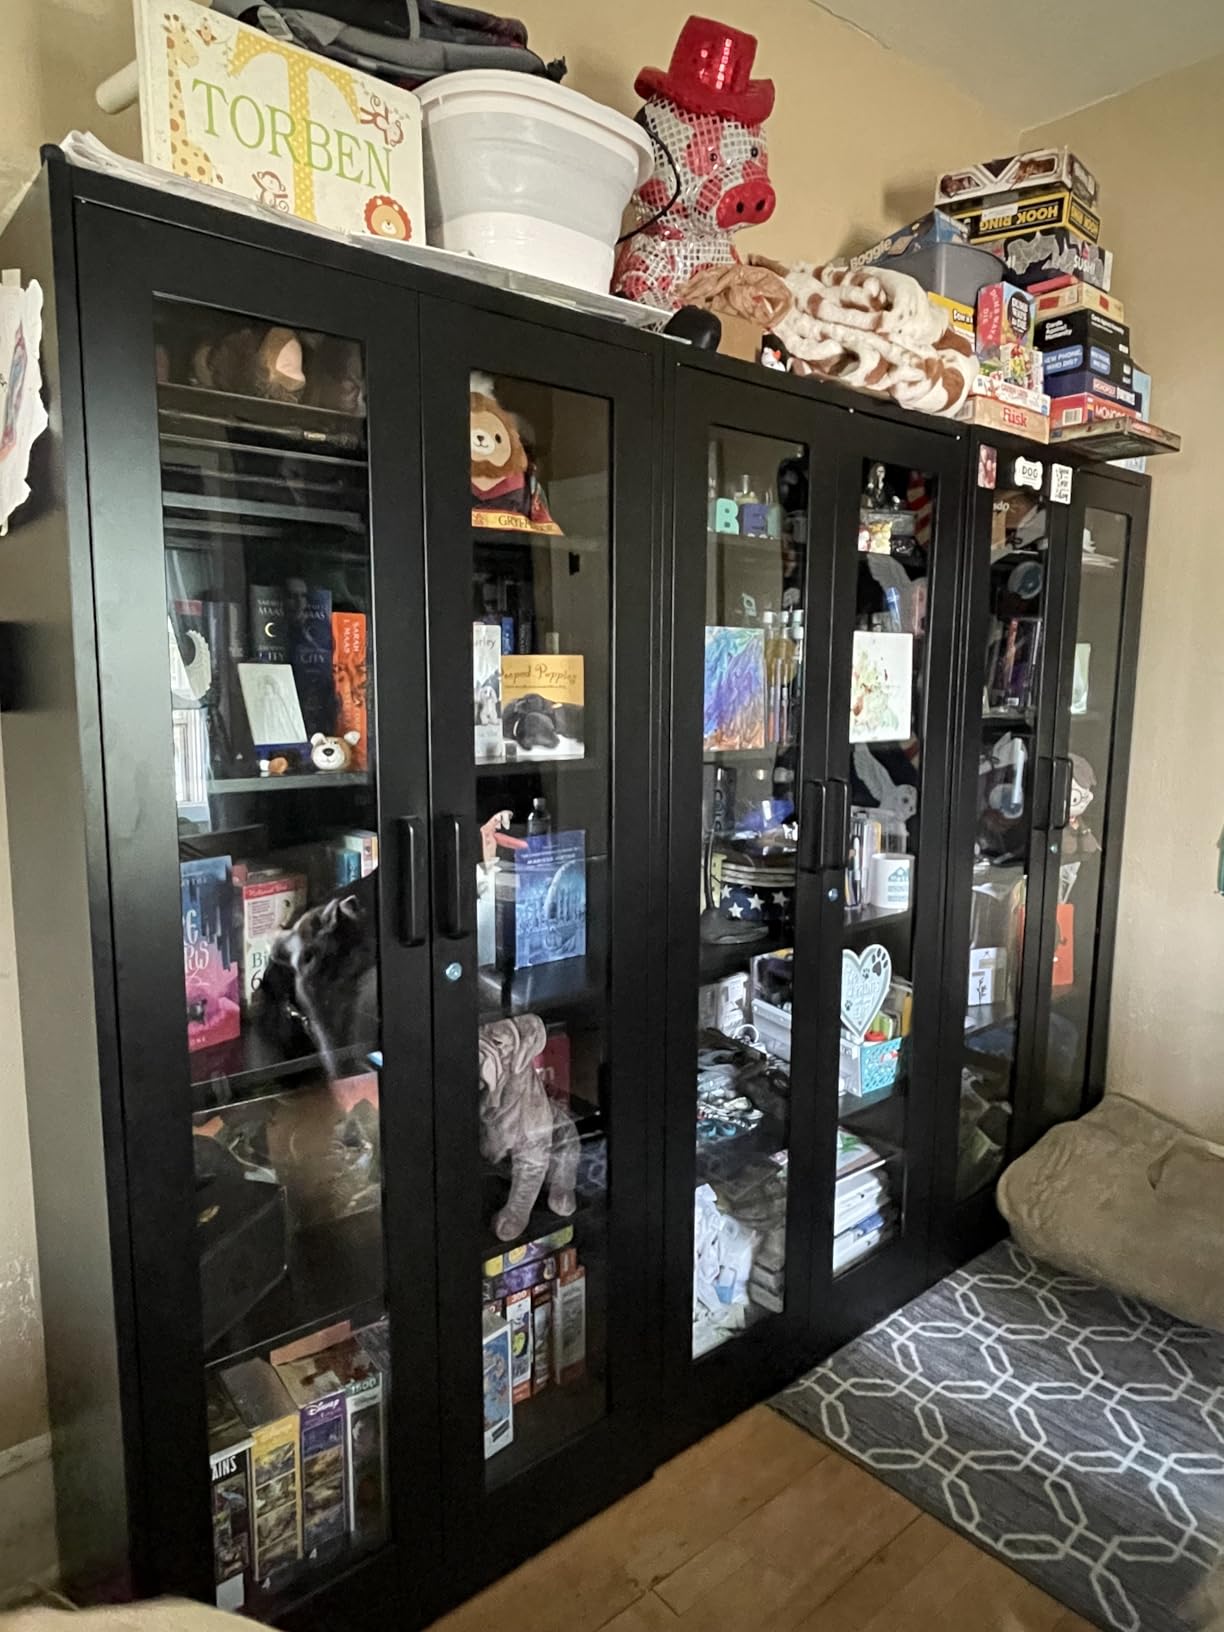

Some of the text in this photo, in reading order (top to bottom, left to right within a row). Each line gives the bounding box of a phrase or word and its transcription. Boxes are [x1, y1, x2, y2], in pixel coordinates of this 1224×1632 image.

[191, 77, 392, 195] TORBEN
[979, 204, 1059, 232] HOOK RING
[849, 238, 893, 272] Boggle
[1022, 465, 1039, 479] DOG
[305, 1398, 341, 1418] Disney
